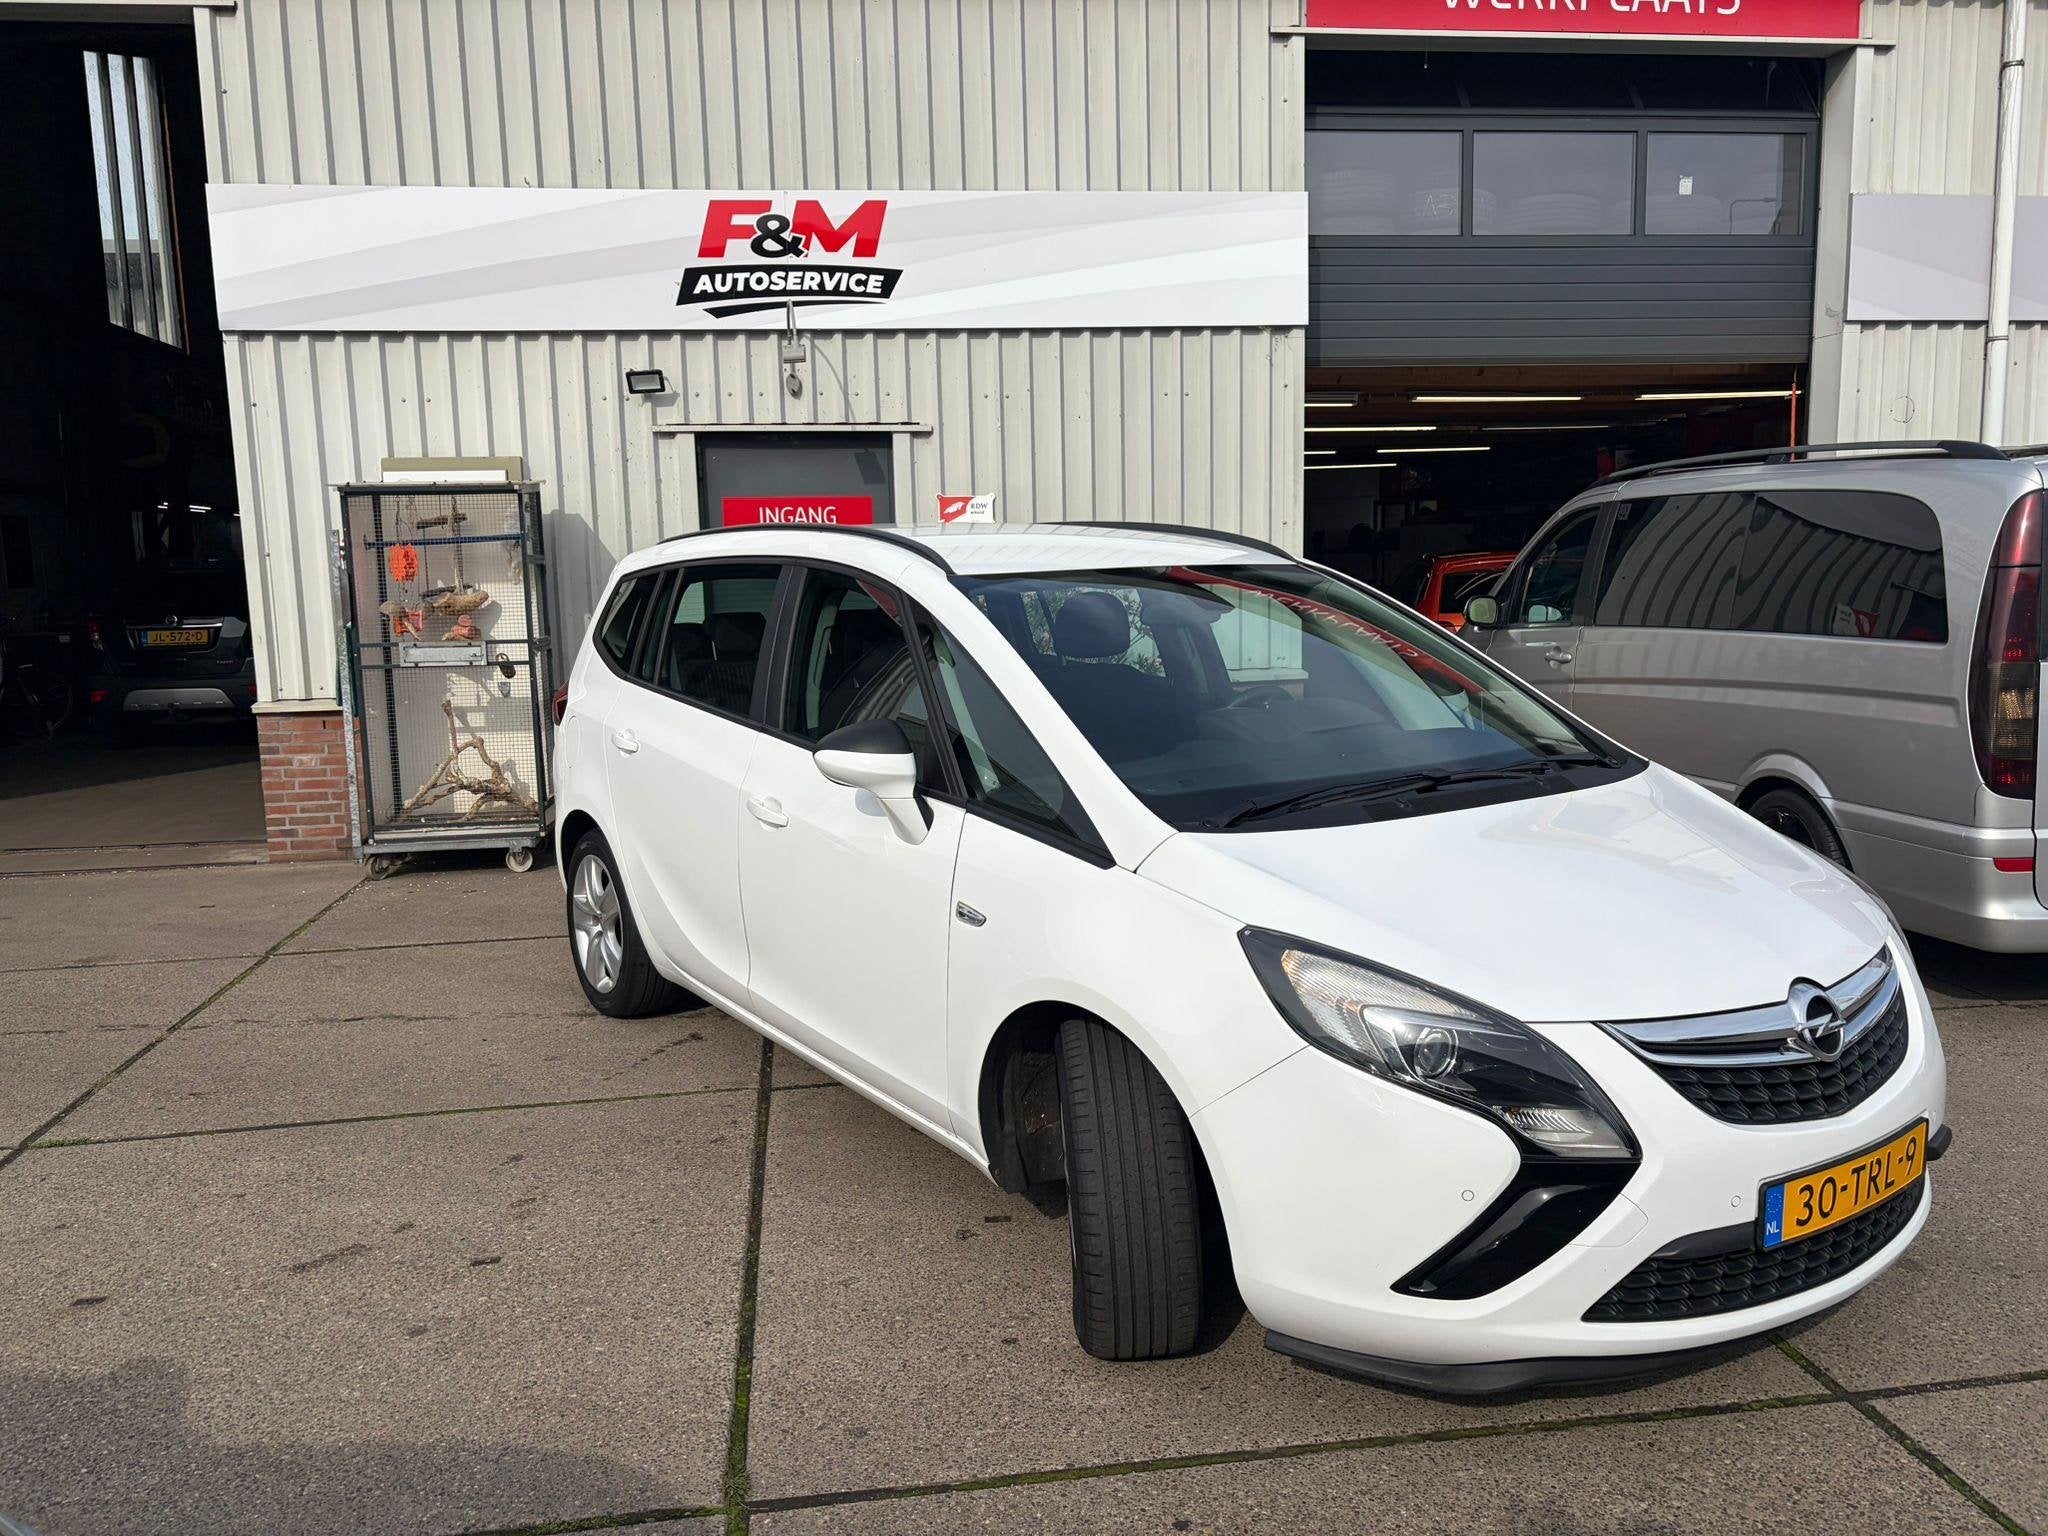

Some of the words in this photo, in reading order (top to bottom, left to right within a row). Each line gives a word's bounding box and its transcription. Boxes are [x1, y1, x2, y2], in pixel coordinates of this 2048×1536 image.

[697, 199, 888, 259] F&M
[693, 270, 885, 295] AUTOSERVICE
[758, 506, 837, 525] INGANG
[970, 502, 988, 510] RDW
[152, 631, 203, 643] JL-572-D
[1795, 1136, 1918, 1228] 30-TRL-9
[1765, 1220, 1780, 1236] NL
